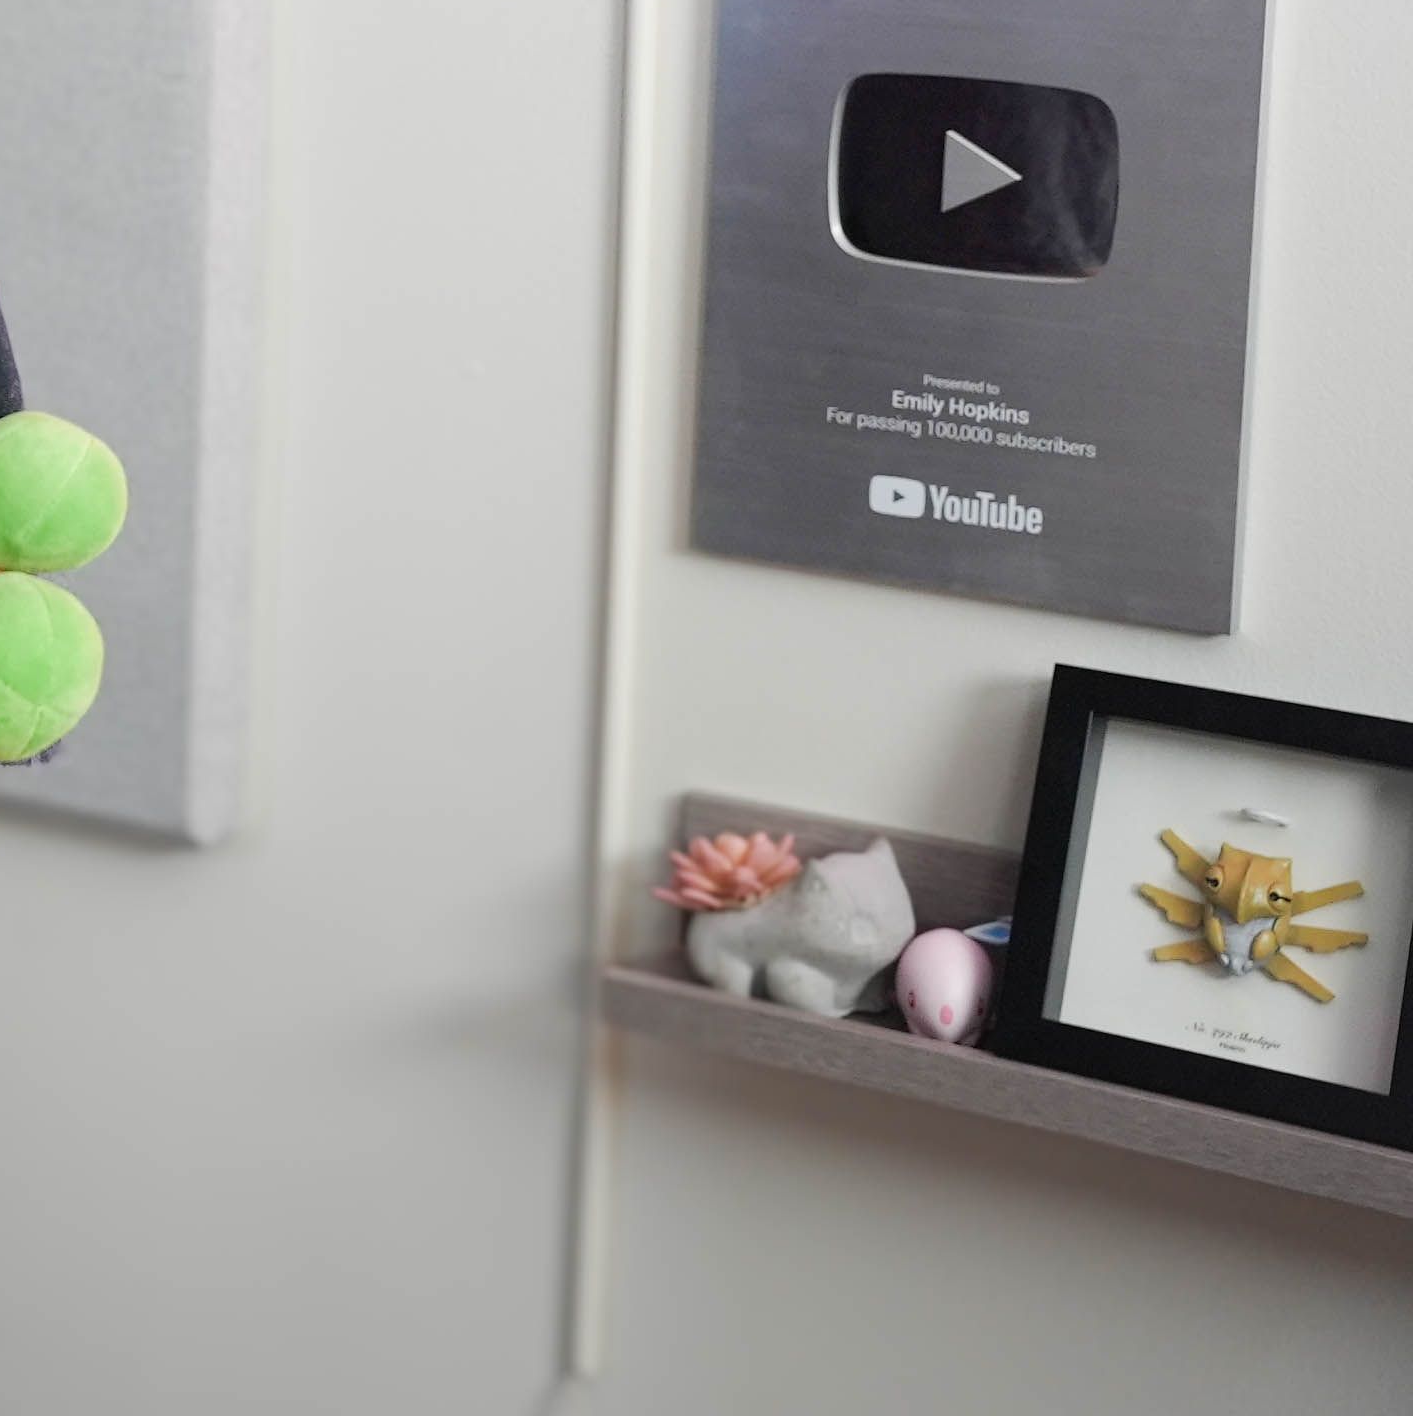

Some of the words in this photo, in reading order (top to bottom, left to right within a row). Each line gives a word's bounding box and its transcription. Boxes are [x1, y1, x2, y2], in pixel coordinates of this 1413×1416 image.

[923, 373, 984, 395] Presented
[985, 383, 1001, 396] to
[891, 389, 945, 417] Emily
[948, 397, 1030, 426] Hopkins
[826, 406, 852, 424] For
[856, 413, 922, 439] passing
[926, 420, 993, 444] 100,000
[995, 430, 1097, 459] subscribers
[928, 483, 1044, 535] YouTube
